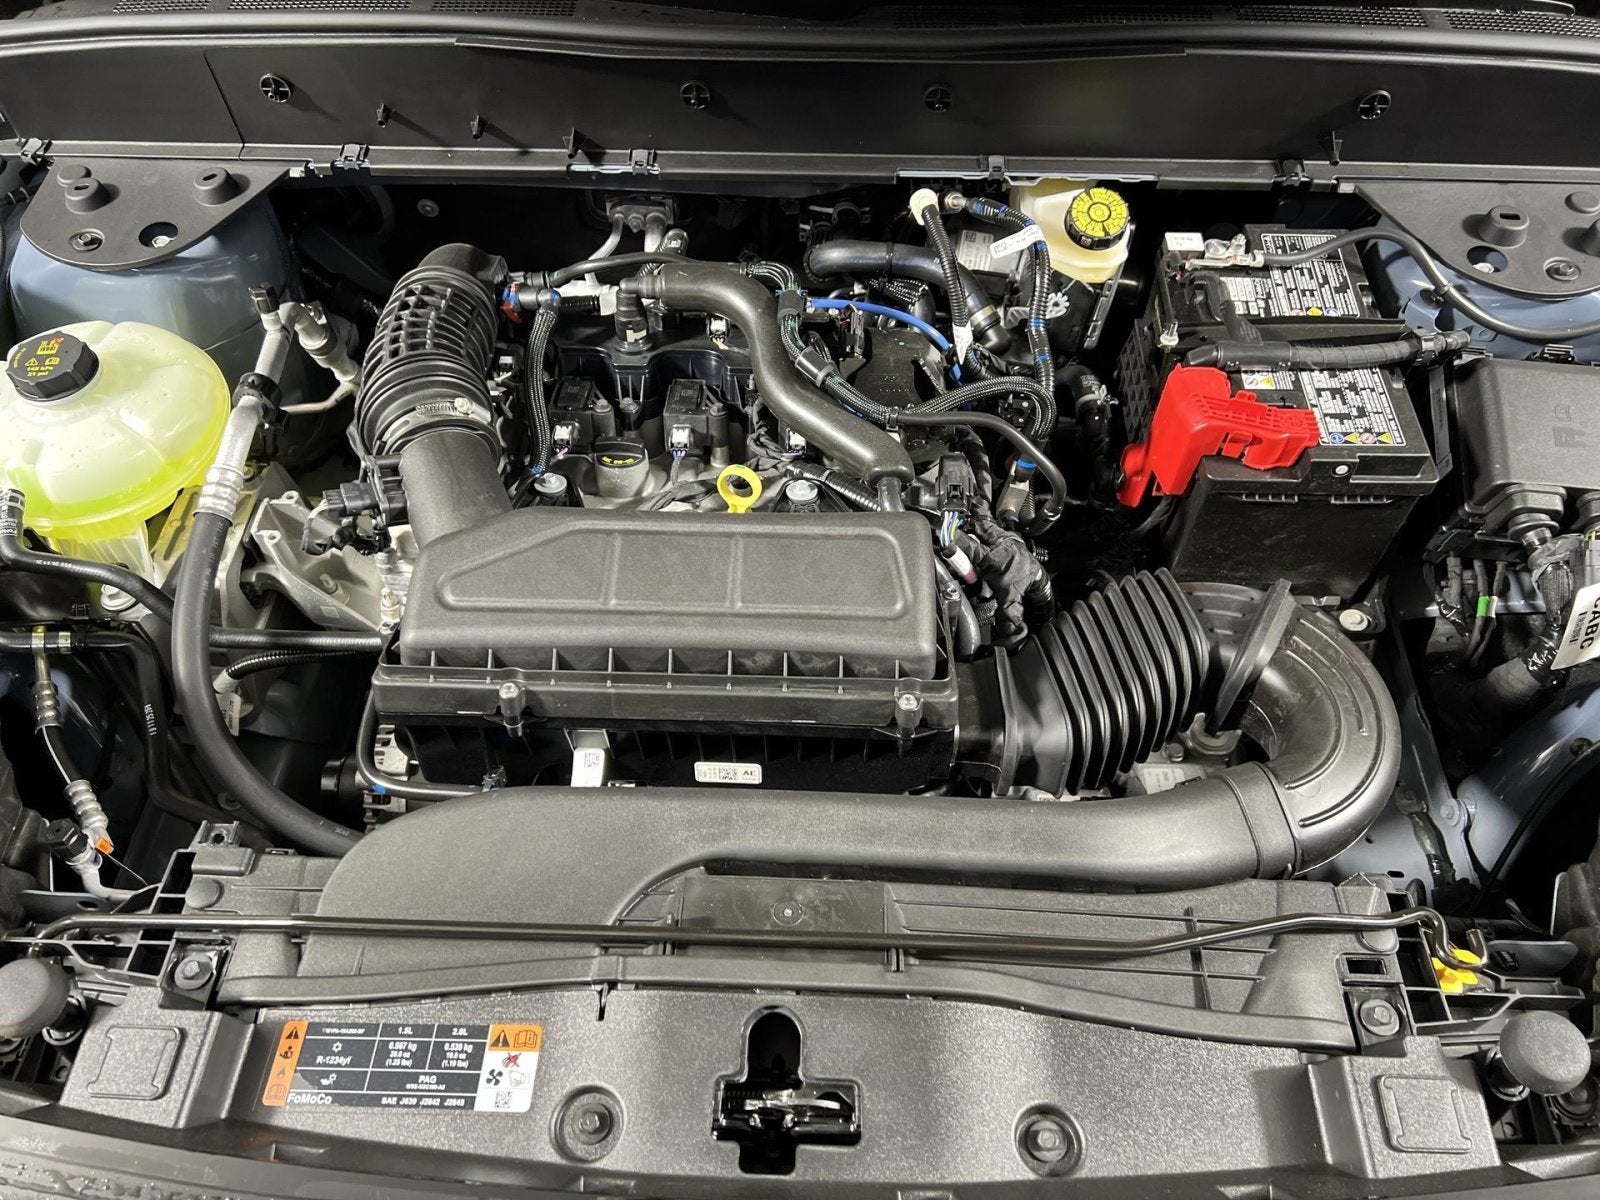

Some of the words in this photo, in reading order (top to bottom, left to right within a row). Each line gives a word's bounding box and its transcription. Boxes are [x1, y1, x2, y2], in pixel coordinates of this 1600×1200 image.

[398, 1026, 413, 1035] 1.5L
[452, 1027, 468, 1036] 2.0L
[408, 1042, 417, 1052] kg
[464, 1043, 473, 1053] kg
[316, 1055, 352, 1067] R-1234yf
[418, 1075, 437, 1084] PAG
[286, 1093, 333, 1105] FoMoCo
[381, 1097, 397, 1105] SAE
